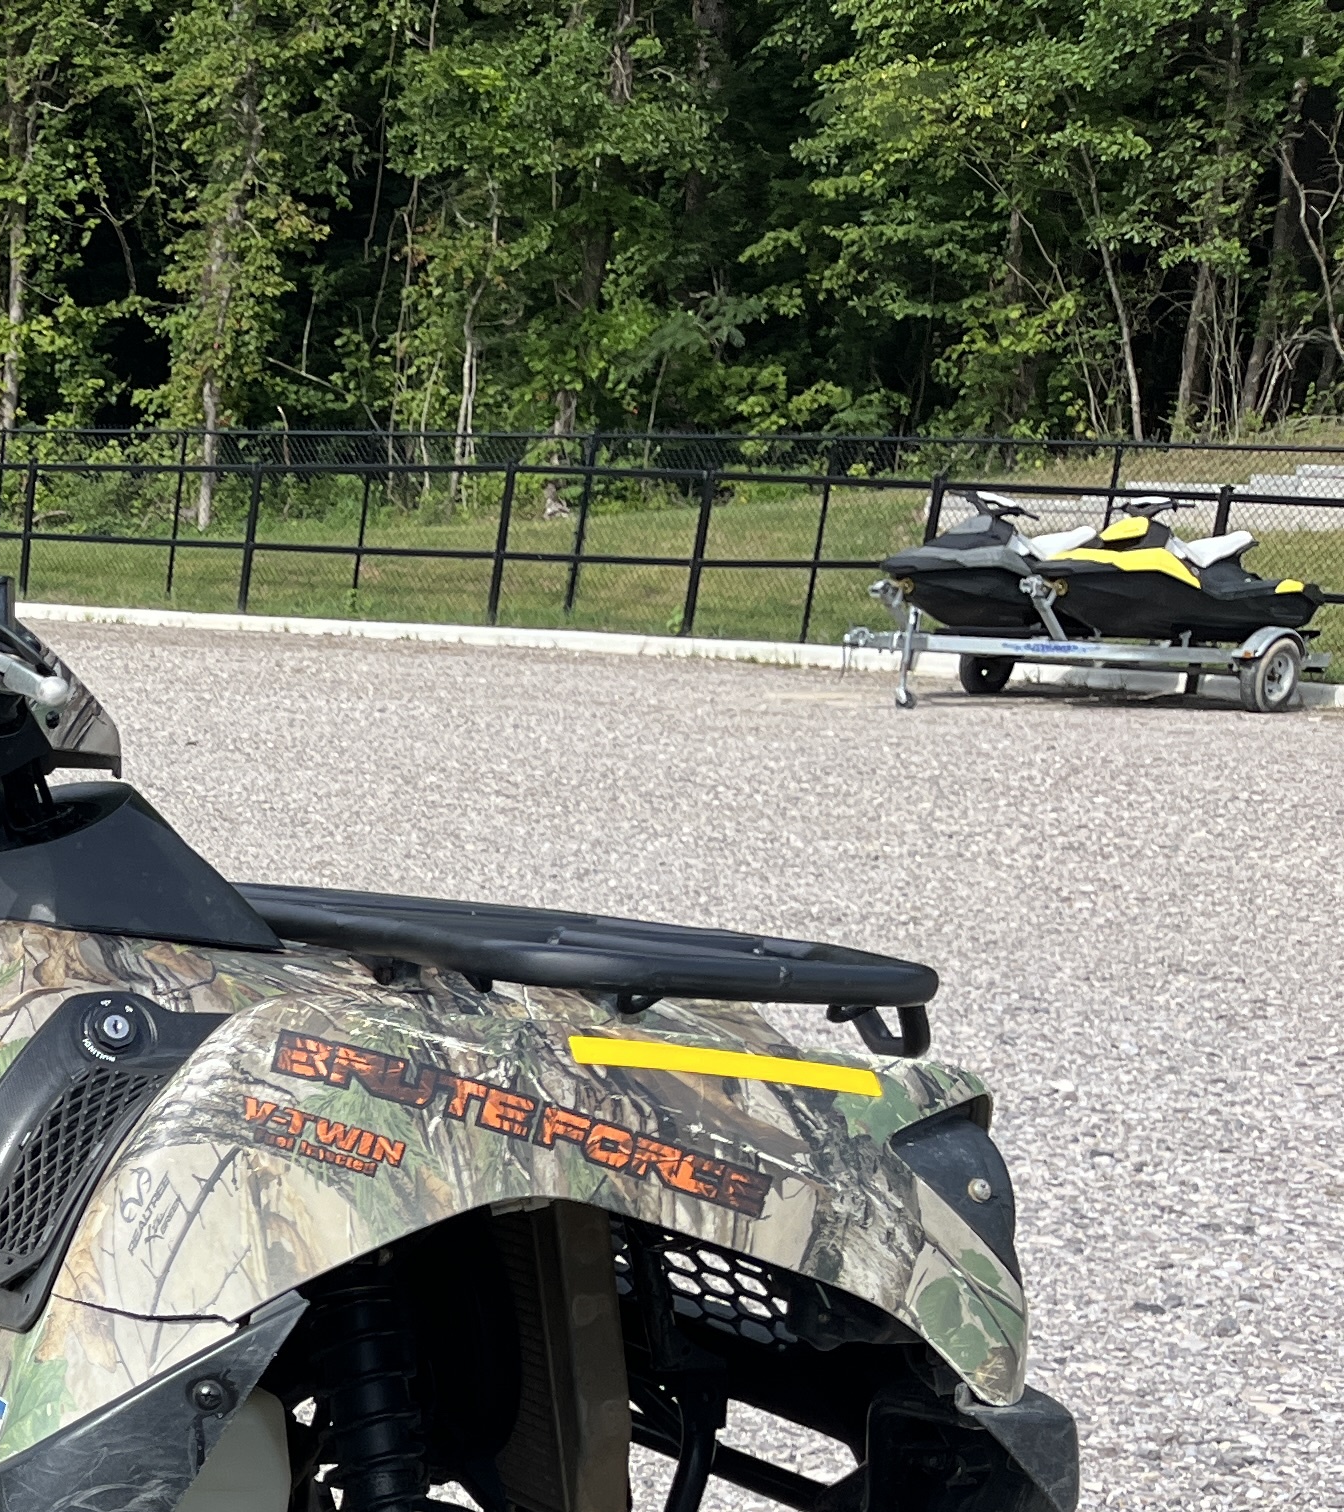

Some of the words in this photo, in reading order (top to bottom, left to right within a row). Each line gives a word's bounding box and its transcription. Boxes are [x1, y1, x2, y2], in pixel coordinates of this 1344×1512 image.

[244, 1096, 406, 1168] V-TWIN
[271, 1028, 537, 1143] BRUTE
[531, 1101, 773, 1219] FORCE
